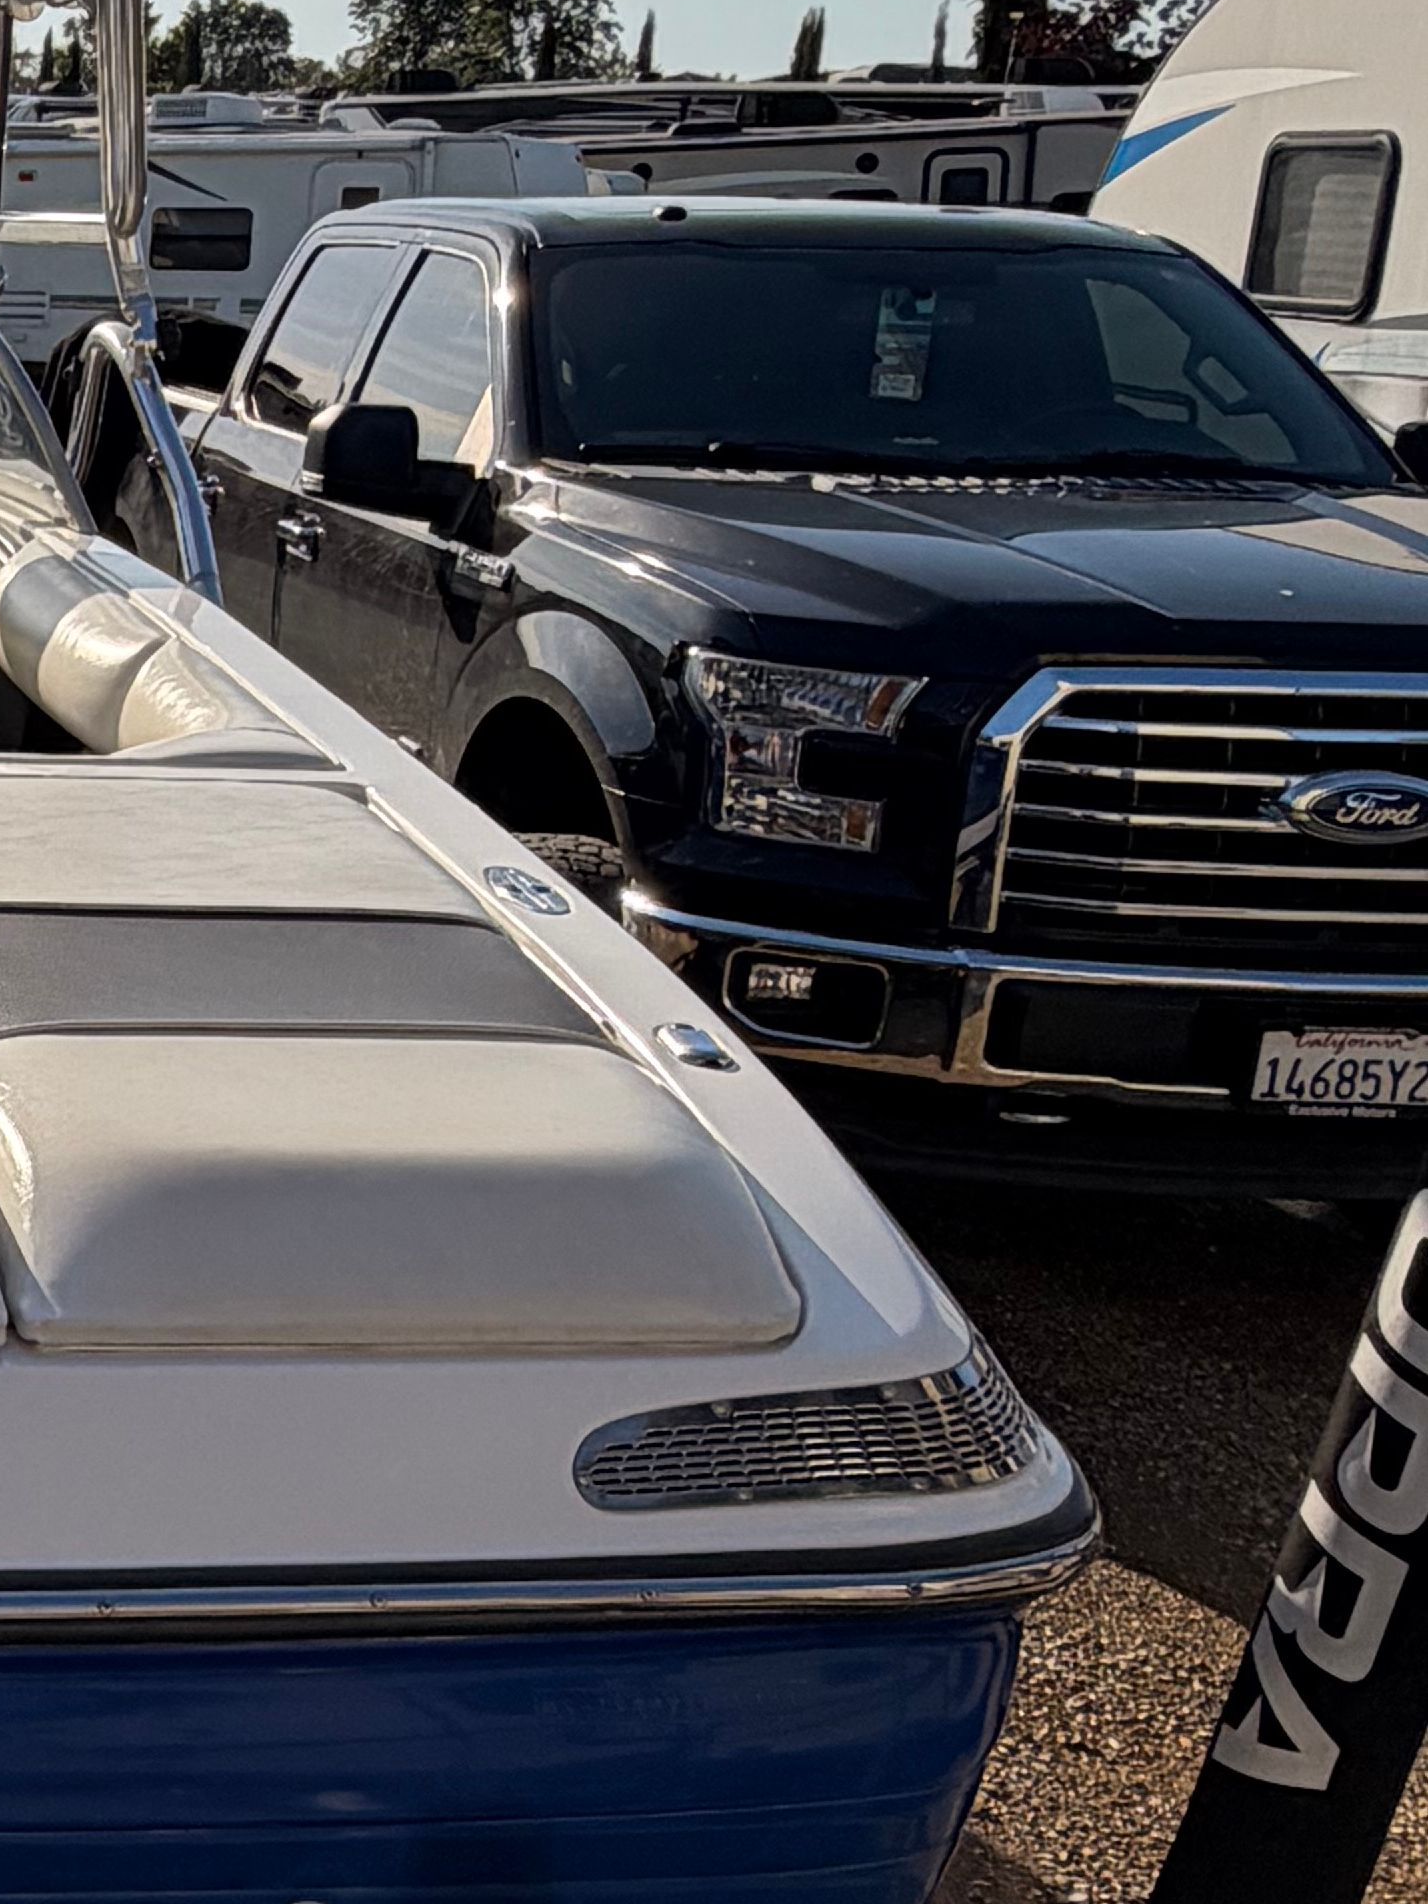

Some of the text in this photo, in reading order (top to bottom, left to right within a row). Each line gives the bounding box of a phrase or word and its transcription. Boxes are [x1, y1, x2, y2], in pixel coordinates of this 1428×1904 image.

[1336, 792, 1421, 829] Ford
[1294, 1031, 1410, 1055] California
[1259, 1057, 1428, 1102] 14685Y2
